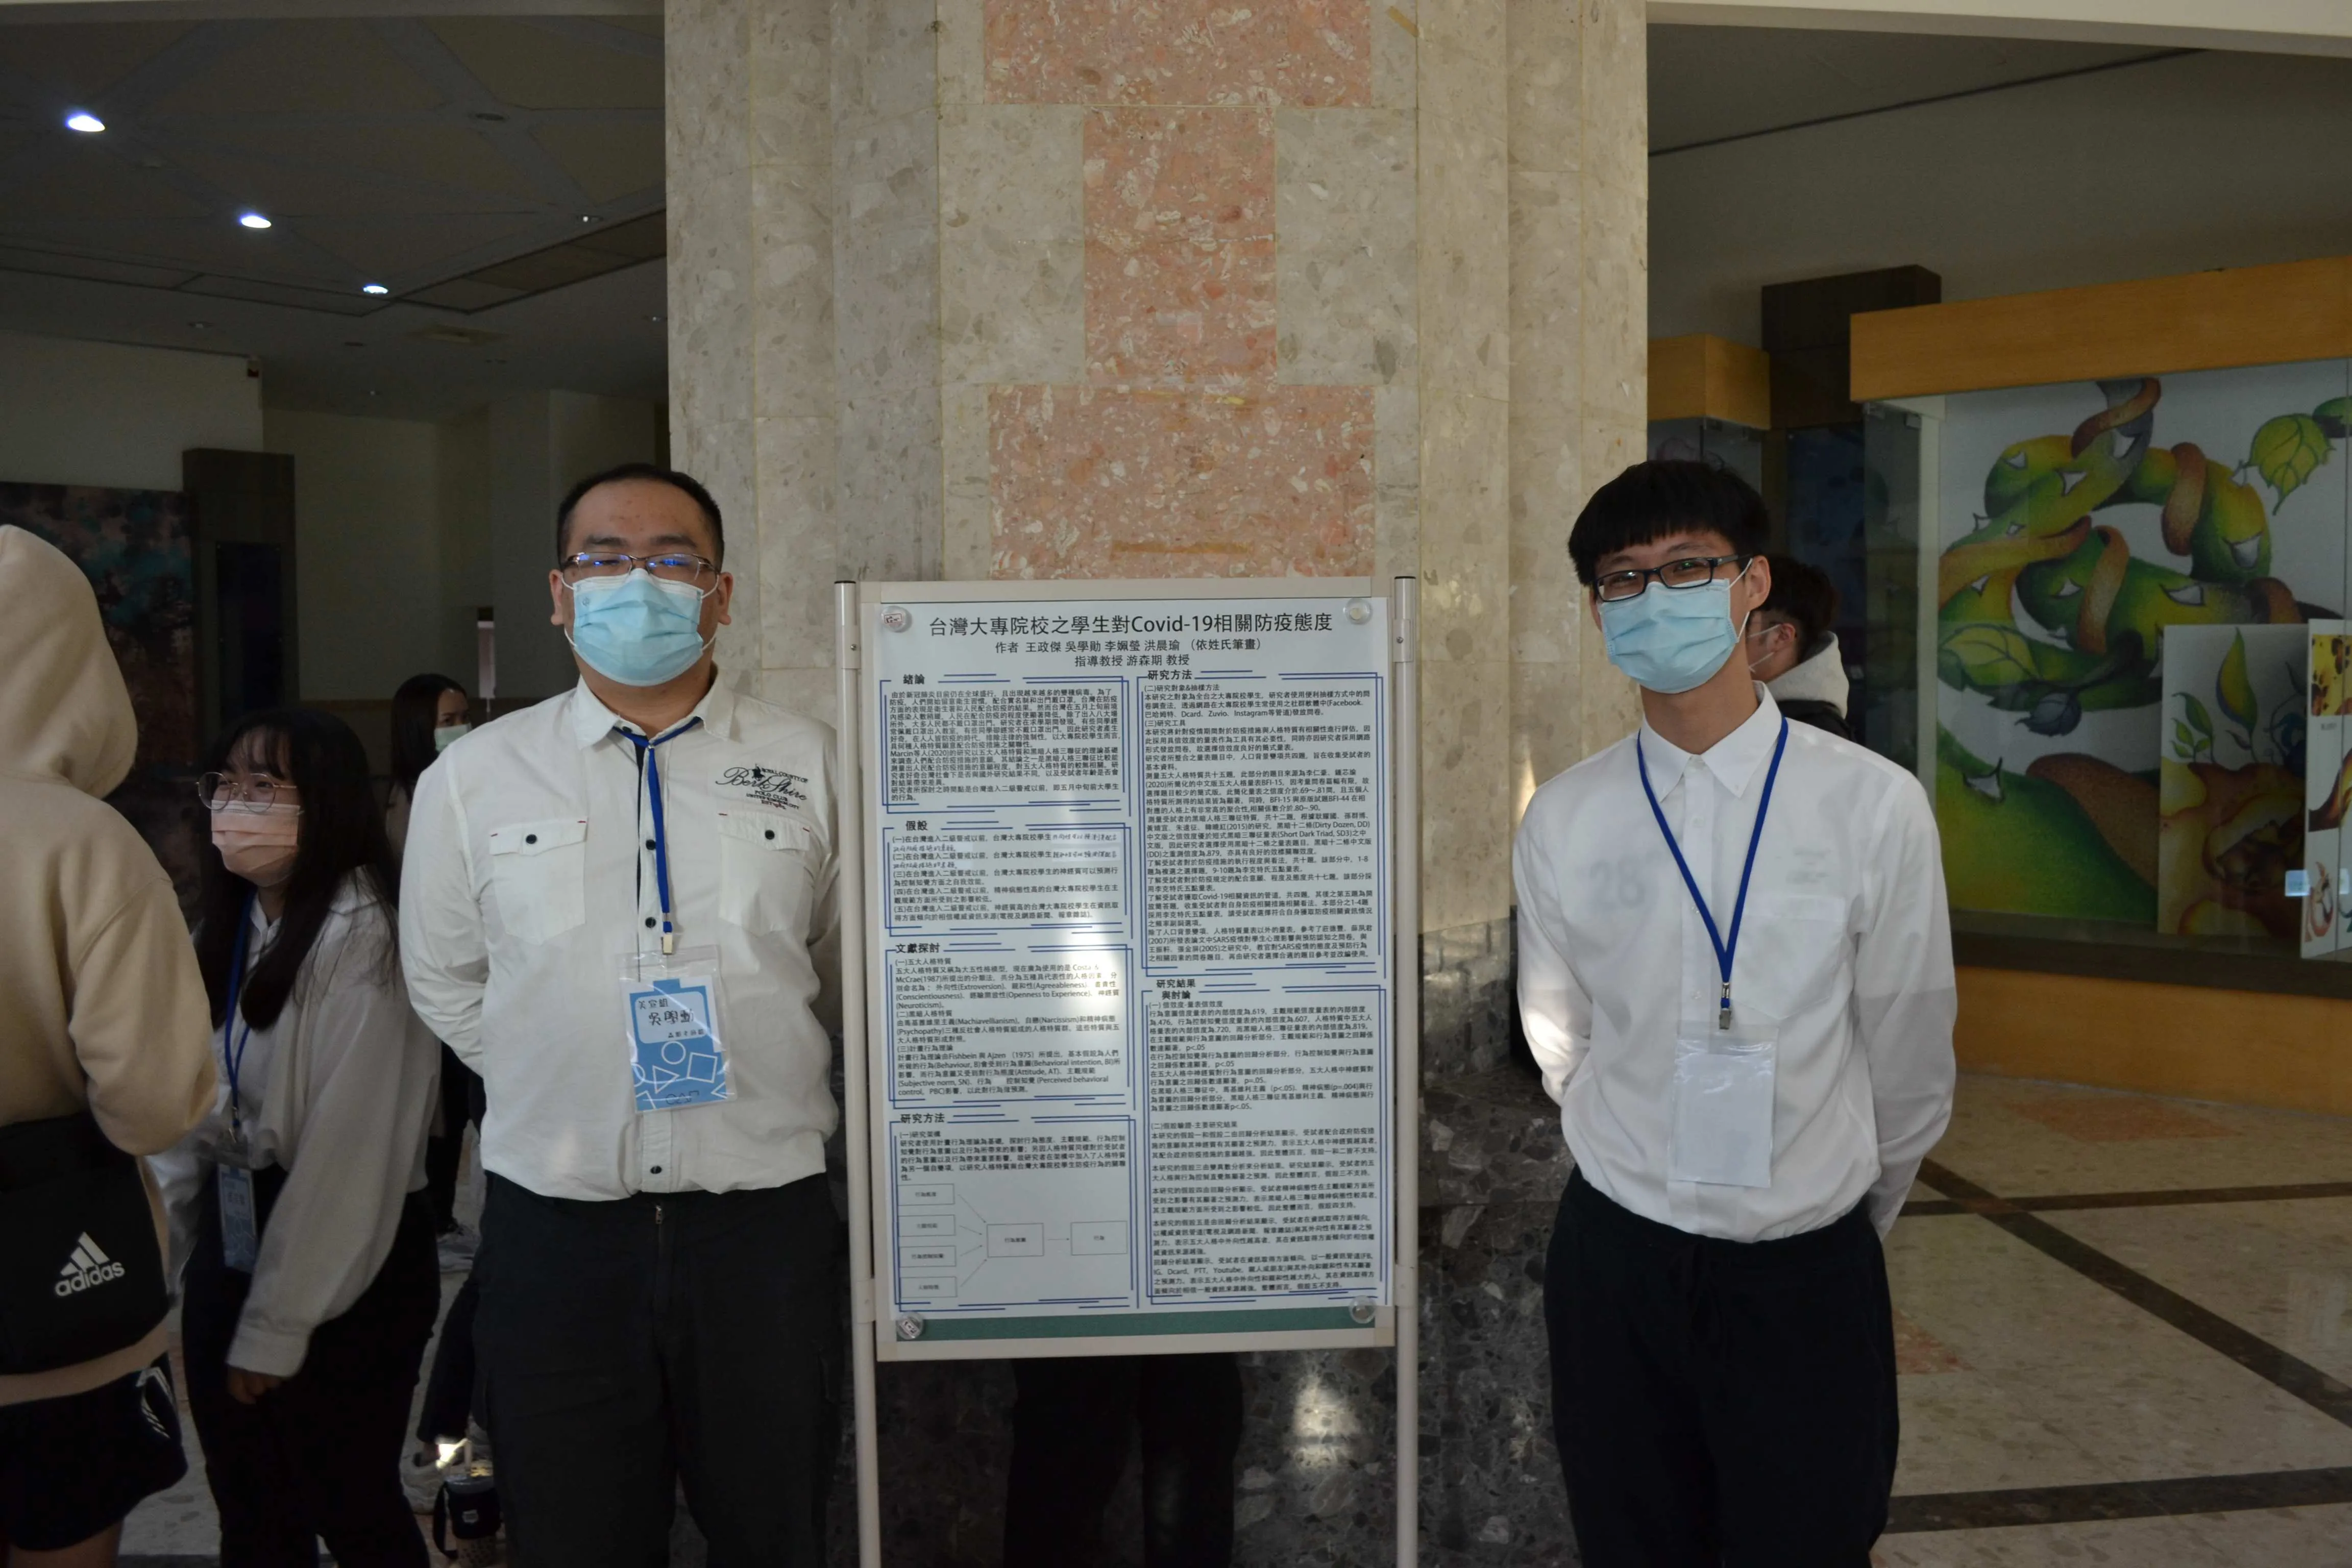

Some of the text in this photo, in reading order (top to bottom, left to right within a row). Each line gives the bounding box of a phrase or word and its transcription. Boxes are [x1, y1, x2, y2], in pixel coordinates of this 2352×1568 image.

[994, 641, 1019, 653] 作者
[1024, 641, 1062, 653] 王政傑
[1143, 639, 1181, 652] 洪晨瑜
[1073, 654, 1190, 667] 指導教授 游森期 教授
[902, 674, 925, 684] 緒論
[1147, 669, 1192, 680] 研究方法
[1144, 719, 1186, 727] (三)研究工具
[904, 820, 929, 831] 假設
[1299, 830, 1315, 838] Dark
[895, 942, 940, 954] 文獻探討
[1155, 978, 1196, 990] 研究結果
[1042, 990, 1050, 998] to
[1161, 989, 1191, 1000] 與討論
[900, 1112, 945, 1124] 研究方法
[55, 1262, 125, 1297] adidas
